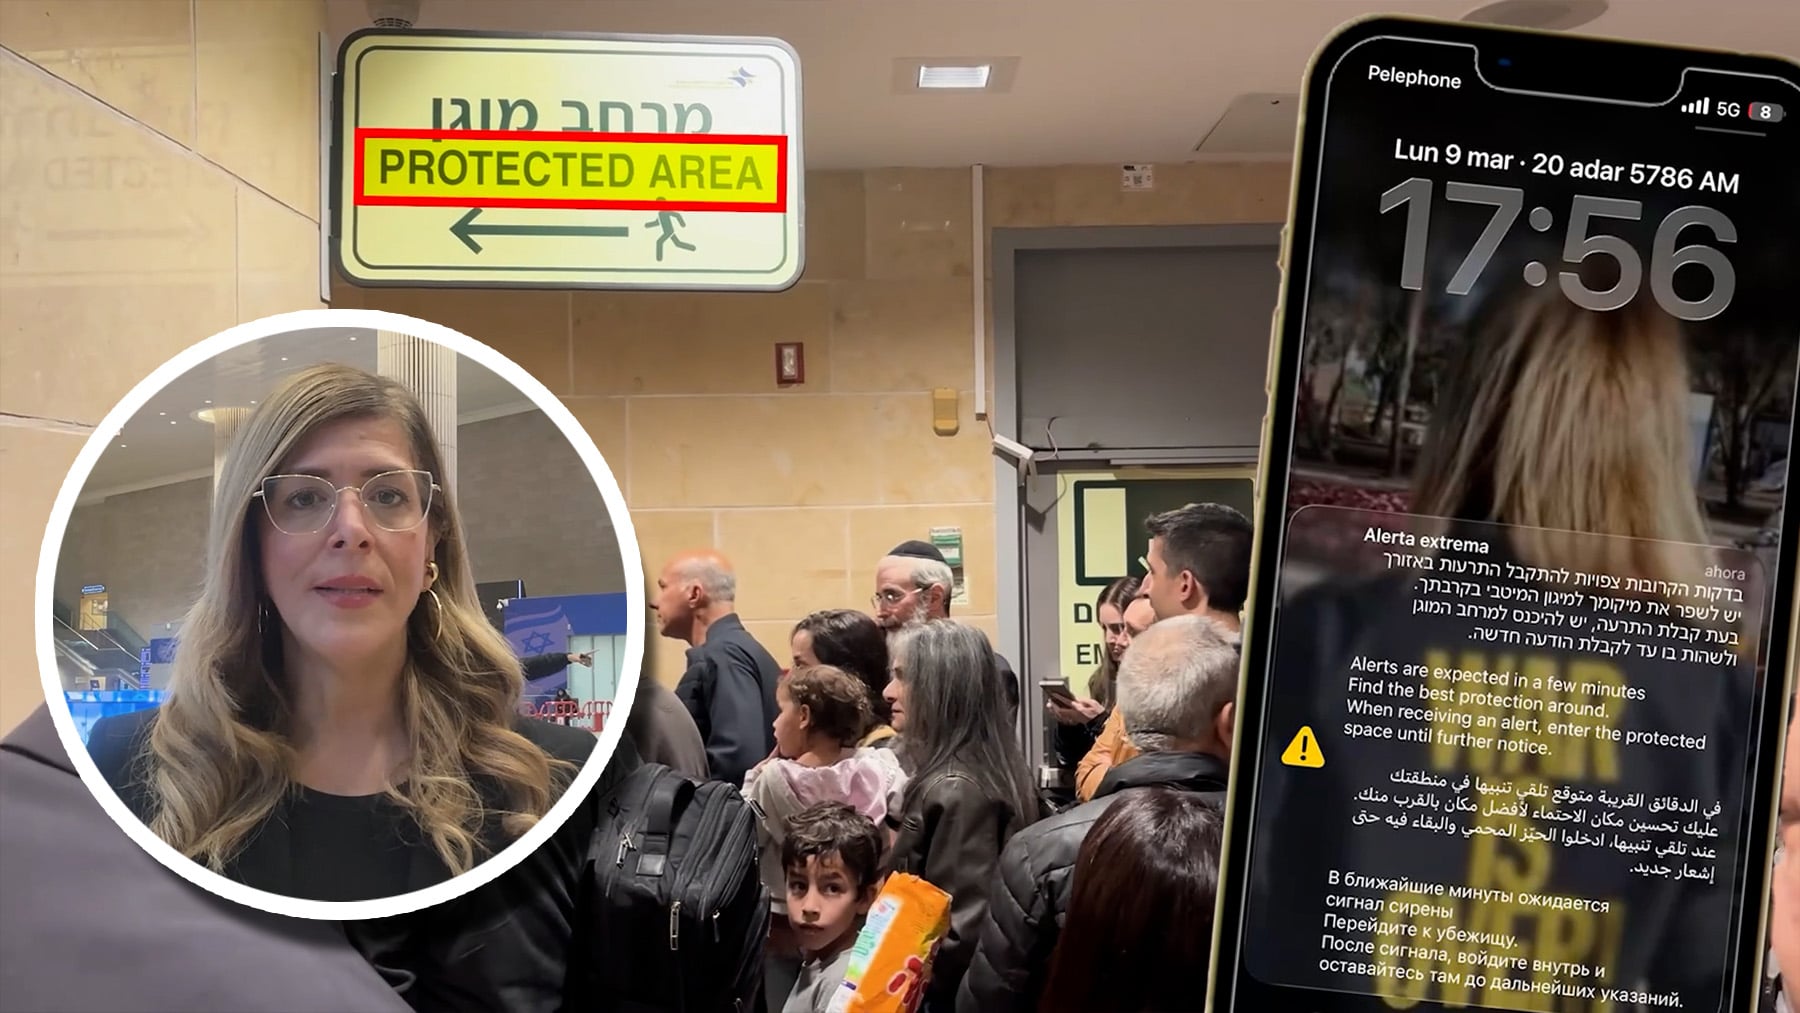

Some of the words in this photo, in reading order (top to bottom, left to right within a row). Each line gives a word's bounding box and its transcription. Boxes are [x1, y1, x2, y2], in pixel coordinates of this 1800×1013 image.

[1368, 64, 1462, 90] Pelephone
[432, 97, 539, 142] מוגן
[560, 100, 714, 134] מרחב
[1716, 101, 1741, 118] 5G
[1760, 105, 1772, 120] 8
[380, 149, 635, 188] PROTECTED
[649, 154, 764, 190] AREA
[1394, 138, 1439, 164] Lun
[1446, 143, 1462, 165] 9
[1467, 149, 1515, 171] mar
[1531, 152, 1564, 176] 20
[1570, 158, 1625, 184] adar
[1630, 163, 1694, 189] 5786
[1699, 170, 1741, 195] AM
[1379, 176, 1738, 321] 17:56
[1363, 527, 1415, 546] Alerta
[1419, 535, 1489, 554] extrema
[1383, 552, 1434, 570] באזורך
[1439, 558, 1501, 577] התרעות
[1505, 561, 1570, 584] להתקבל
[1573, 572, 1621, 590] צפויות
[1704, 564, 1746, 581] ahora
[1414, 577, 1481, 598] בקרבתך.
[1486, 585, 1539, 603] המיטבי
[1625, 577, 1689, 598] הקרובות
[1693, 585, 1744, 603] בדקות
[1412, 599, 1452, 615] המוגן
[1543, 590, 1584, 607] למיגון
[1589, 595, 1642, 614] מיקומך
[1456, 603, 1508, 621] למרחב
[1512, 609, 1565, 626] להיכנס
[1646, 601, 1670, 616] את
[1675, 604, 1720, 621] לשפר
[1723, 609, 1742, 623] יש
[1569, 615, 1588, 629] יש
[1591, 618, 1653, 636] התרעה,
[1468, 627, 1521, 644] חדשה.
[1525, 632, 1574, 649] הודעה
[1657, 622, 1701, 644] קבלת
[1704, 629, 1739, 645] בעת
[1577, 635, 1632, 657] לקבלת
[1636, 643, 1657, 658] עד
[1661, 646, 1677, 660] בו
[1681, 648, 1737, 666] ולשהות
[1350, 656, 1398, 675] Alerts
[1402, 664, 1429, 678] are
[1433, 667, 1510, 686] expected
[1513, 672, 1528, 688] in
[1532, 677, 1542, 689] a
[1547, 675, 1577, 693] few
[1581, 681, 1646, 701] minutes
[1348, 677, 1384, 695] Find
[1387, 681, 1415, 698] the
[1419, 684, 1455, 702] best
[1459, 692, 1544, 711] protection
[1547, 700, 1609, 718] around.
[1347, 698, 1393, 717] When
[1398, 707, 1472, 729] receiving
[1476, 715, 1497, 728] an
[1500, 715, 1542, 736] alert,
[1547, 722, 1591, 737] enter
[1595, 724, 1622, 741] the
[1625, 730, 1706, 750] protected
[1343, 723, 1393, 739] space
[1397, 727, 1433, 743] until
[1437, 729, 1494, 749] further
[1497, 738, 1552, 755] notice.
[1390, 768, 1447, 787] منطقتك
[1451, 774, 1471, 794] في
[1353, 787, 1389, 803] منك.
[1516, 783, 1549, 801] تلقي
[1551, 785, 1594, 804] متوقع
[1597, 790, 1644, 809] القريبة
[1393, 793, 1440, 811] بالقرب
[1444, 796, 1478, 813] مكان
[1482, 799, 1528, 817] لأفضل
[1648, 796, 1699, 813] الدقائق
[1702, 800, 1722, 820] في
[1352, 809, 1381, 825] حتى
[1385, 811, 1408, 829] فيه
[1532, 805, 1587, 823] الاحتماء
[1590, 811, 1624, 828] مكان
[1412, 813, 1457, 835] والبقاء
[1461, 823, 1517, 838] المحمي
[1628, 818, 1679, 833] تحسين
[1683, 821, 1718, 839] عليك
[1561, 828, 1605, 847] ادخلوا
[1655, 841, 1688, 859] تلقي
[1691, 846, 1716, 859] عند
[1629, 862, 1672, 878] جديد.
[1674, 863, 1715, 885] إشعار
[1328, 870, 1340, 885] В
[1344, 871, 1445, 896] ближайшие
[1448, 886, 1514, 904] минуты
[1518, 892, 1610, 913] ожидается
[1326, 894, 1385, 911] сигнал
[1388, 901, 1454, 919] сирены
[1323, 913, 1418, 937] Перейдите
[1422, 926, 1432, 938] к
[1436, 925, 1518, 950] убежищу.
[1321, 934, 1375, 954] После
[1379, 943, 1451, 965] сигнала,
[1457, 950, 1528, 970] войдите
[1532, 959, 1590, 978] внутрь
[1594, 966, 1605, 978] и
[1319, 959, 1425, 981] оставайтесь
[1429, 970, 1460, 985] там
[1463, 974, 1487, 989] до
[1489, 977, 1596, 999] дальнейших
[1601, 988, 1683, 1008] указаний.
